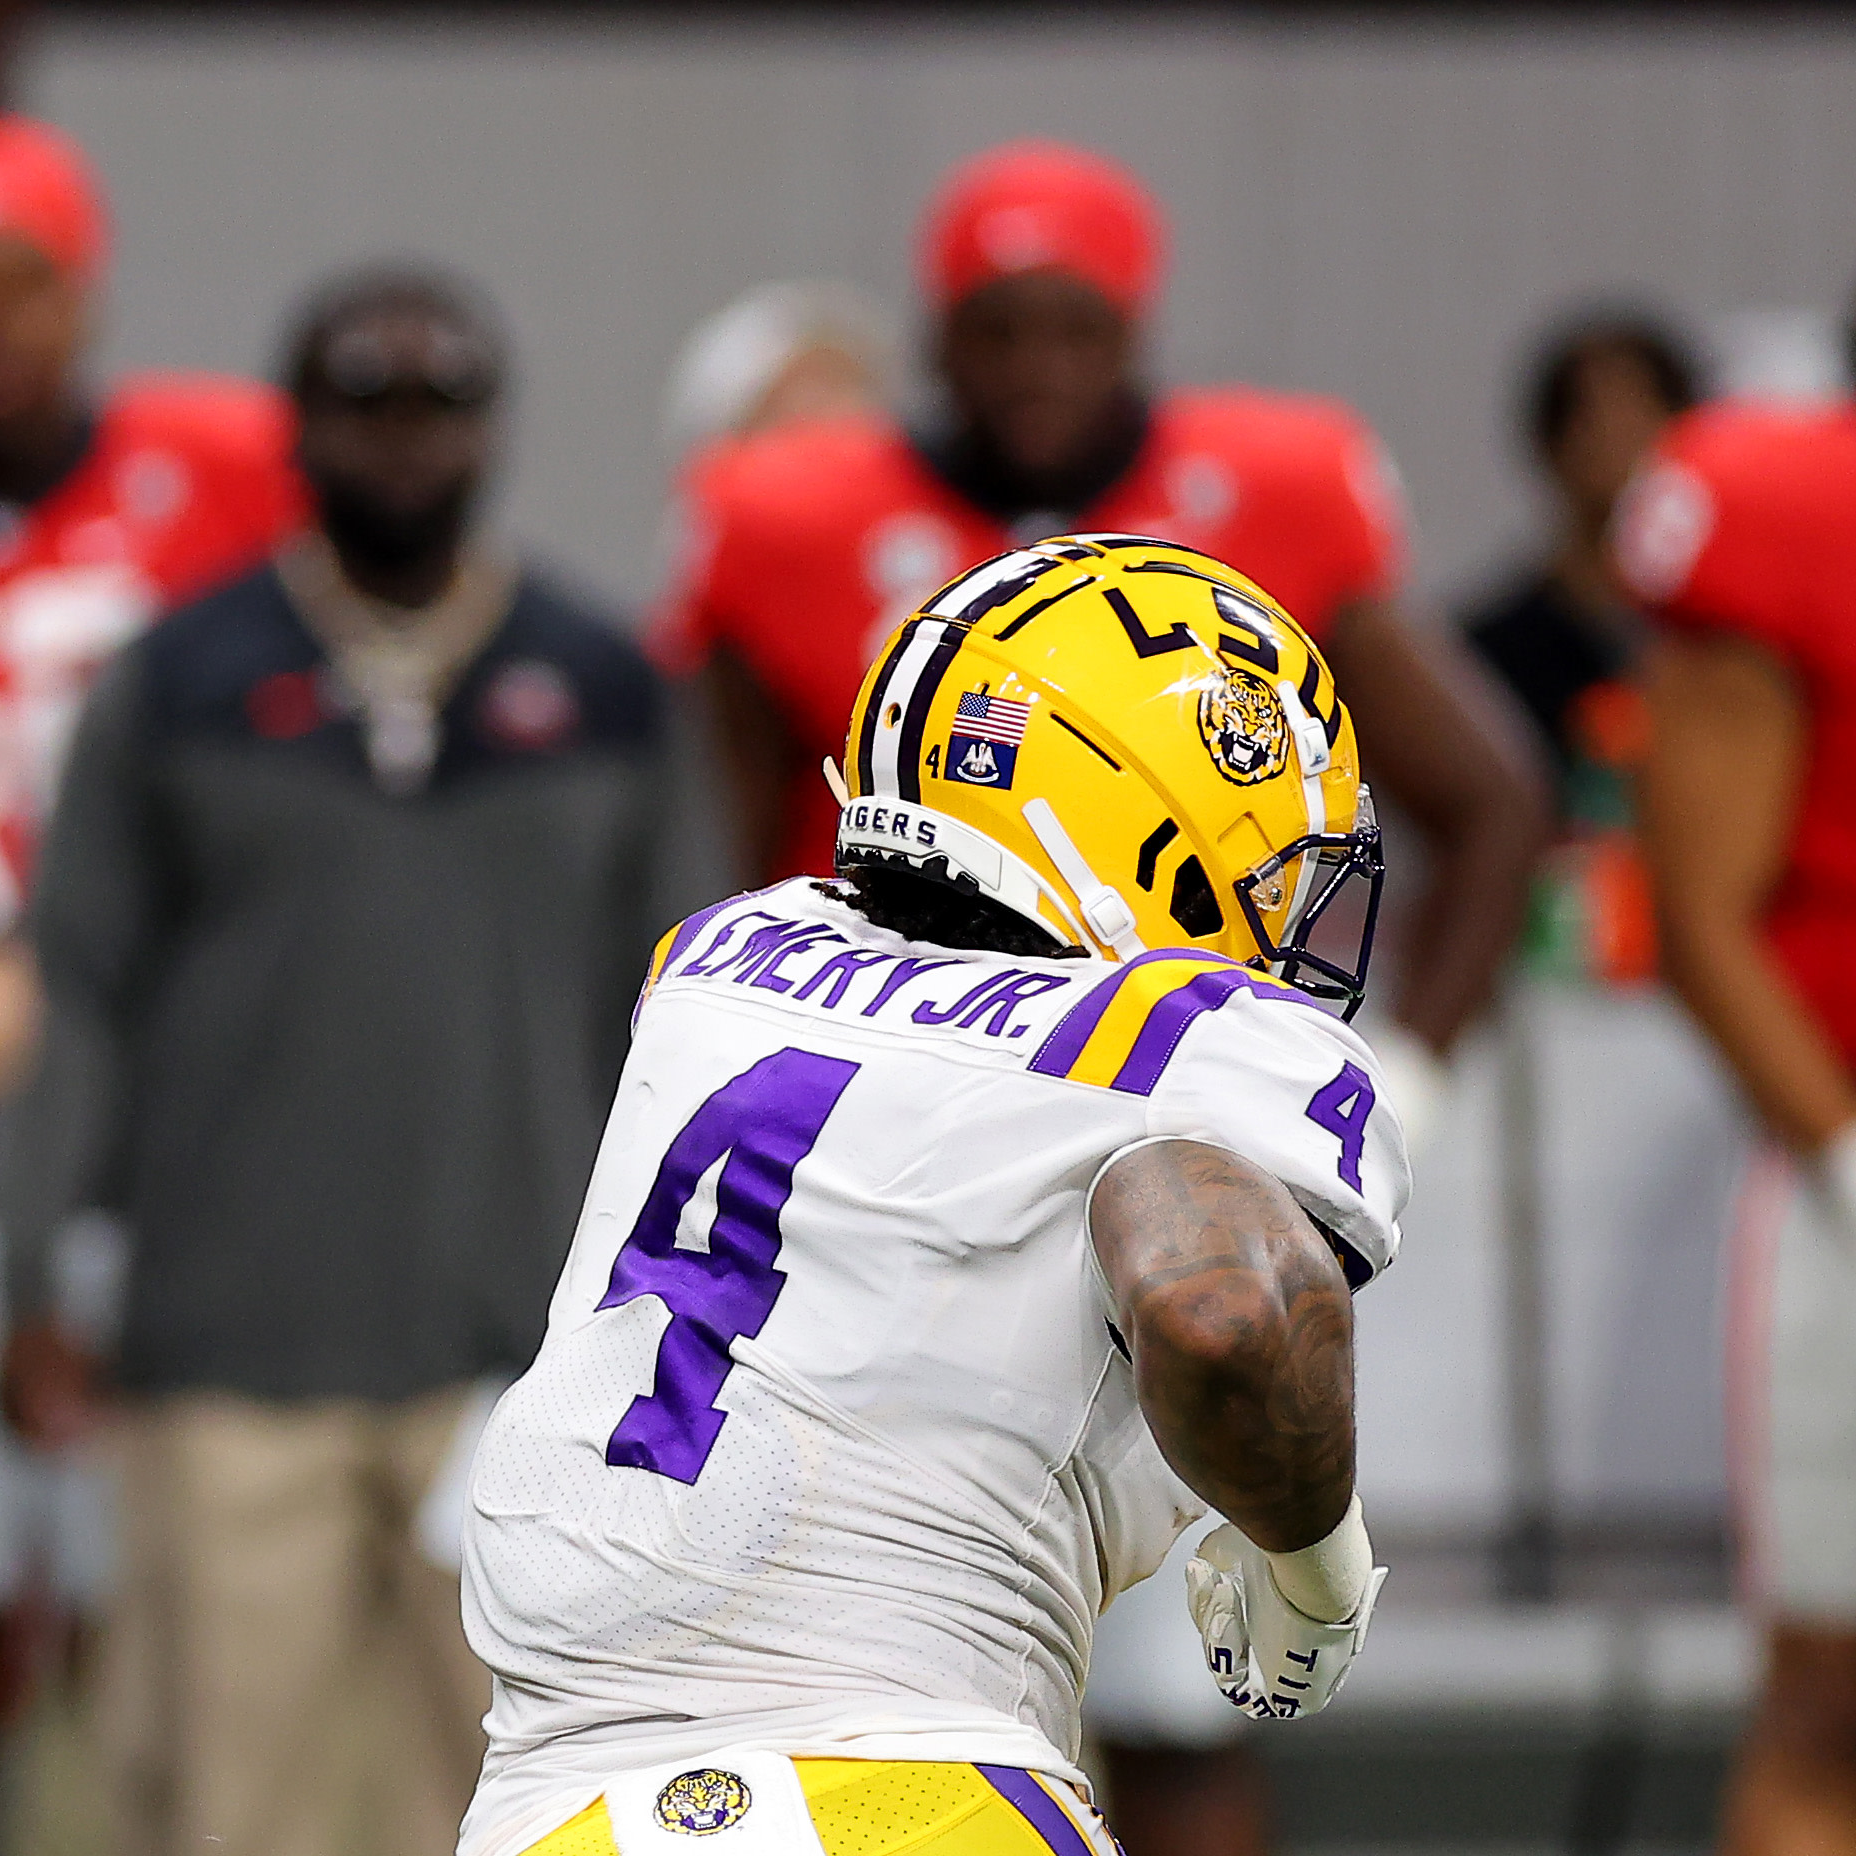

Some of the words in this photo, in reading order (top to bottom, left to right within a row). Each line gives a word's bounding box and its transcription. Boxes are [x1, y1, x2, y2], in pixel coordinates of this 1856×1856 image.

[1102, 587, 1341, 748] LSU
[925, 744, 941, 779] 4
[677, 911, 965, 1018] EMERY
[911, 969, 1072, 1038] JR.
[1304, 1058, 1376, 1199] 4
[593, 1046, 862, 1487] 4
